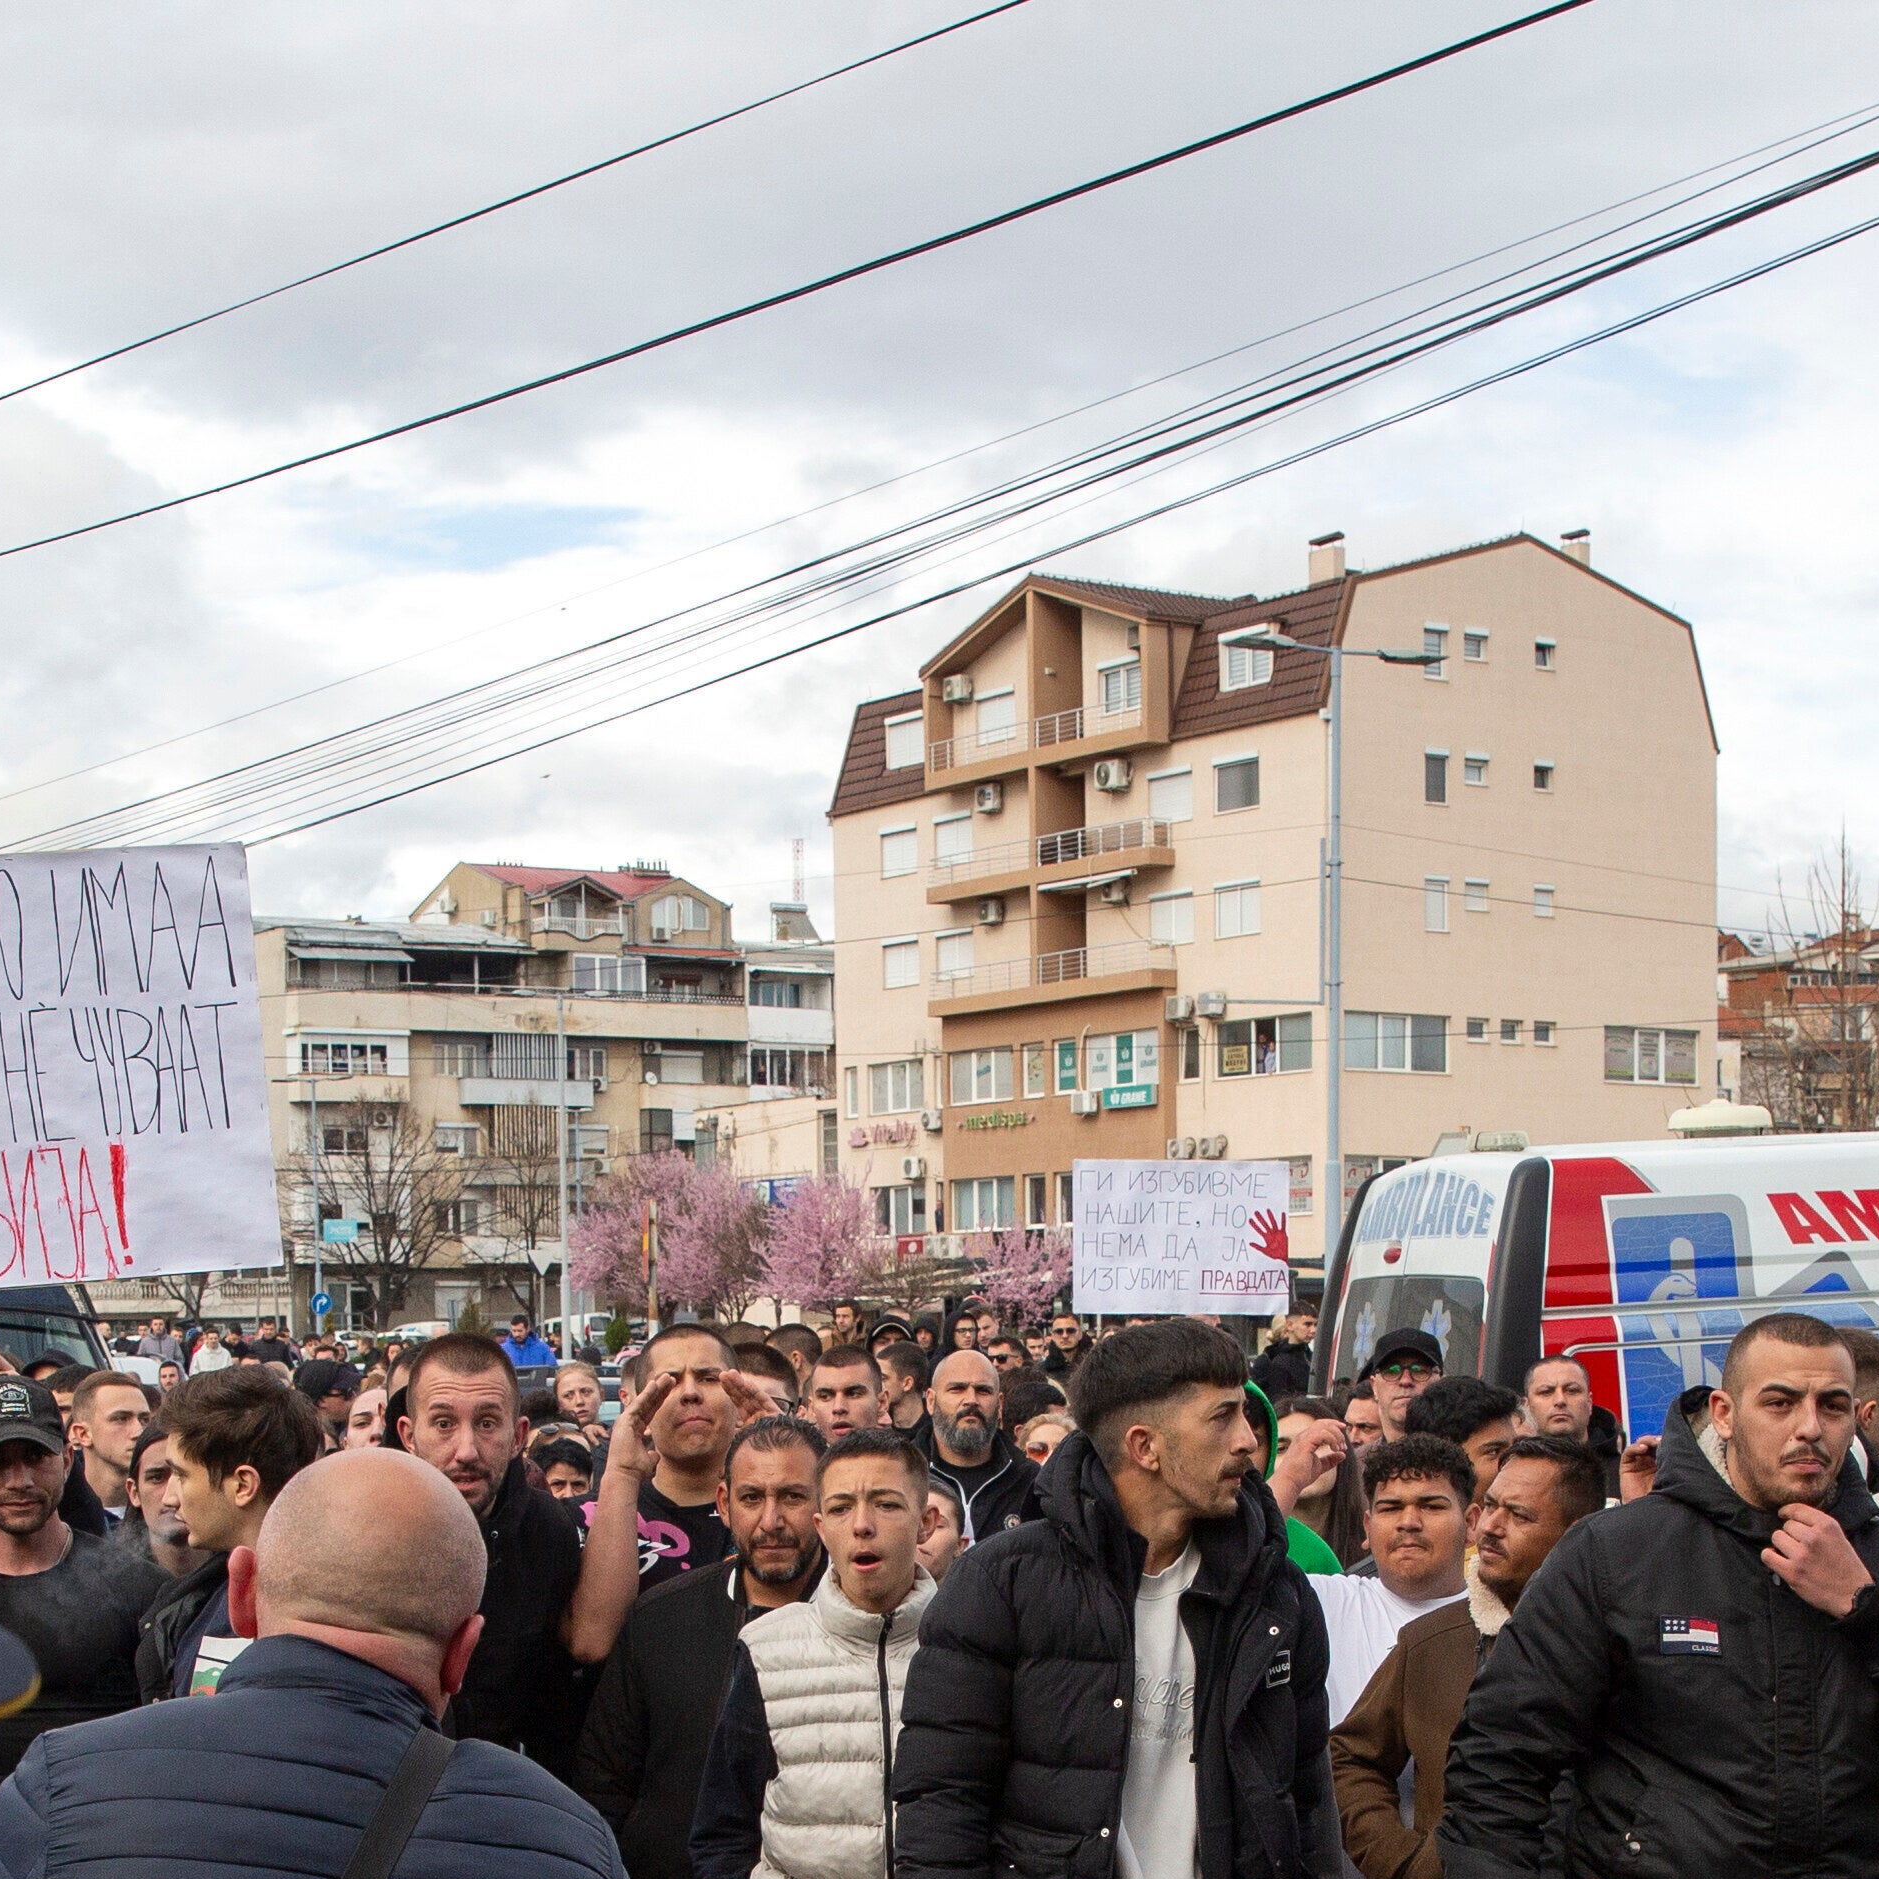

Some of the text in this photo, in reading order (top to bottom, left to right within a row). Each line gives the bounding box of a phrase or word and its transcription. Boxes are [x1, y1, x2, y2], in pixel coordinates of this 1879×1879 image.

[51, 855, 238, 997] ИМАА
[70, 1001, 239, 1136] ЧУВААТ
[1079, 1169, 1113, 1193] ГИ
[1128, 1169, 1270, 1199] ИЗГУБИВМЕ
[1085, 1201, 1247, 1229] НАШИТЕ, НО
[1356, 1169, 1496, 1245] AMBULANCE
[1081, 1231, 1250, 1262] НЕМА ДА ЈА
[1081, 1266, 1289, 1293] ИЗГУБИМЕ ПРАВДАТА
